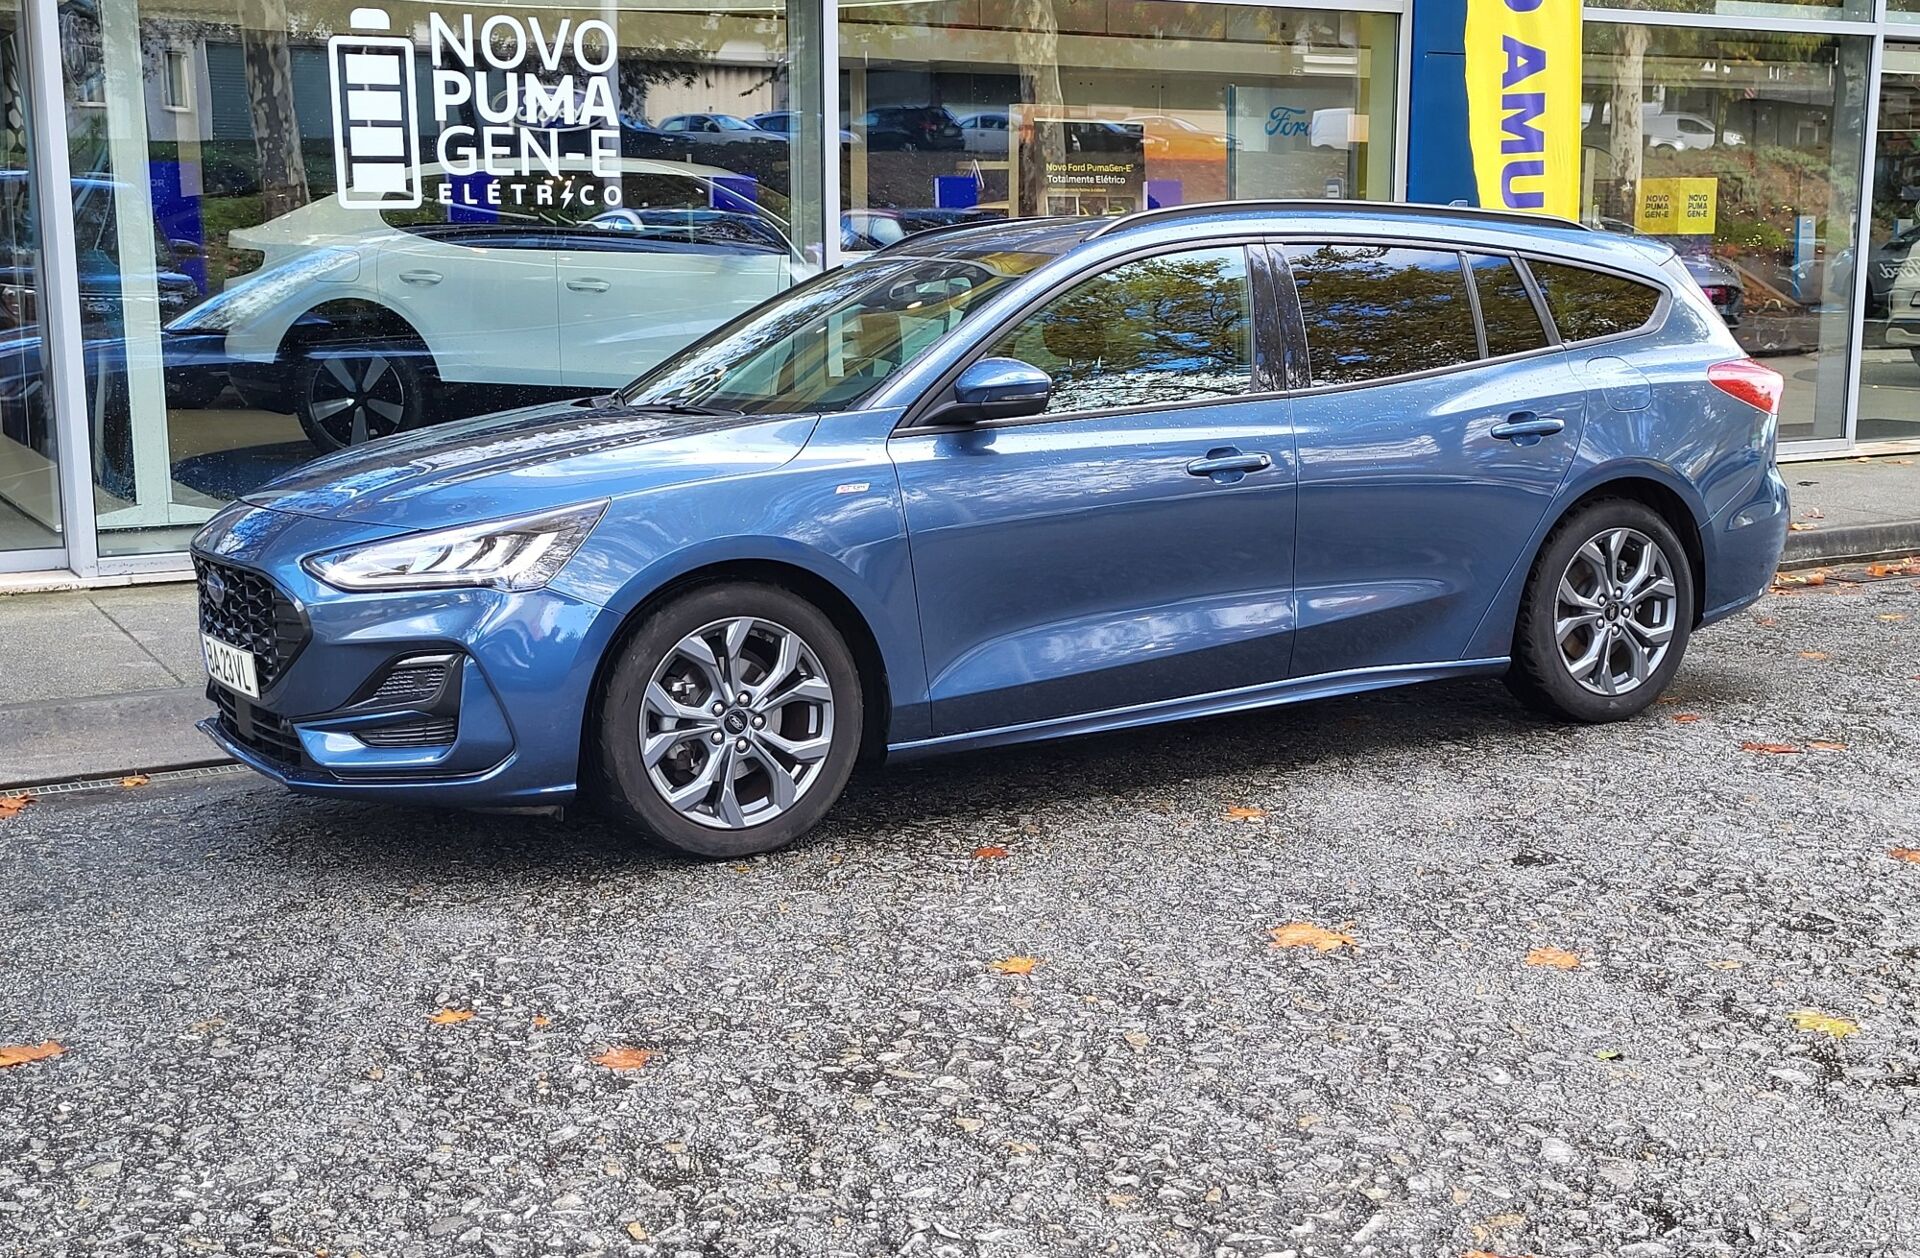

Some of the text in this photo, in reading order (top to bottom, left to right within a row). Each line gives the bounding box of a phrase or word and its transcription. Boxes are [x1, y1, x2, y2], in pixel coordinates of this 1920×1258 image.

[429, 11, 618, 73] NOVO
[432, 69, 620, 126] PUMA
[436, 125, 621, 177] GEN-E
[1046, 163, 1067, 172] Novo
[1067, 163, 1086, 172] Ford
[1046, 174, 1126, 184] Totalmente Elétrico
[1646, 194, 1670, 202] NOVO
[1688, 194, 1708, 202] NOVO
[1645, 202, 1669, 210] PUMA
[1687, 202, 1708, 210] PUMA
[1644, 210, 1669, 218] GEN-E
[1686, 210, 1708, 218] GEN-E
